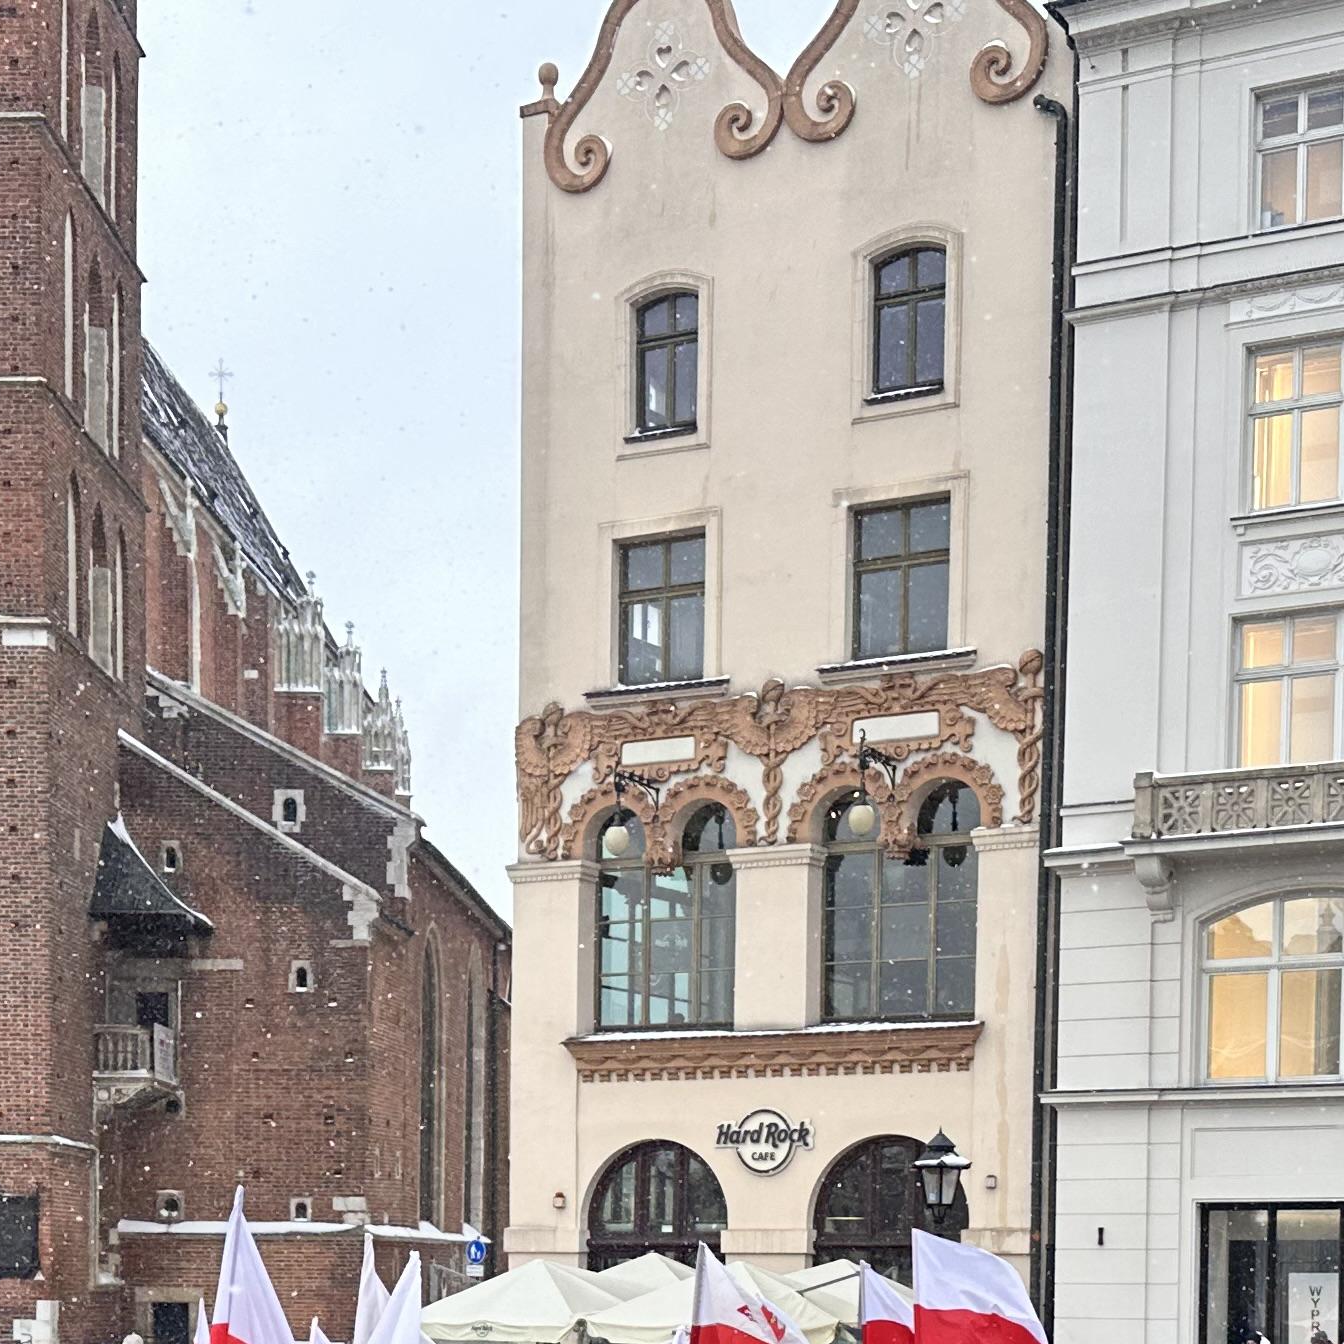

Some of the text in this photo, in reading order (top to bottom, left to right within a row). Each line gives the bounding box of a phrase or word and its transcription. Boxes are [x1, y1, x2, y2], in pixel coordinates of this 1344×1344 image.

[716, 1121, 810, 1149] Hard Rock
[751, 1152, 776, 1161] CAFE
